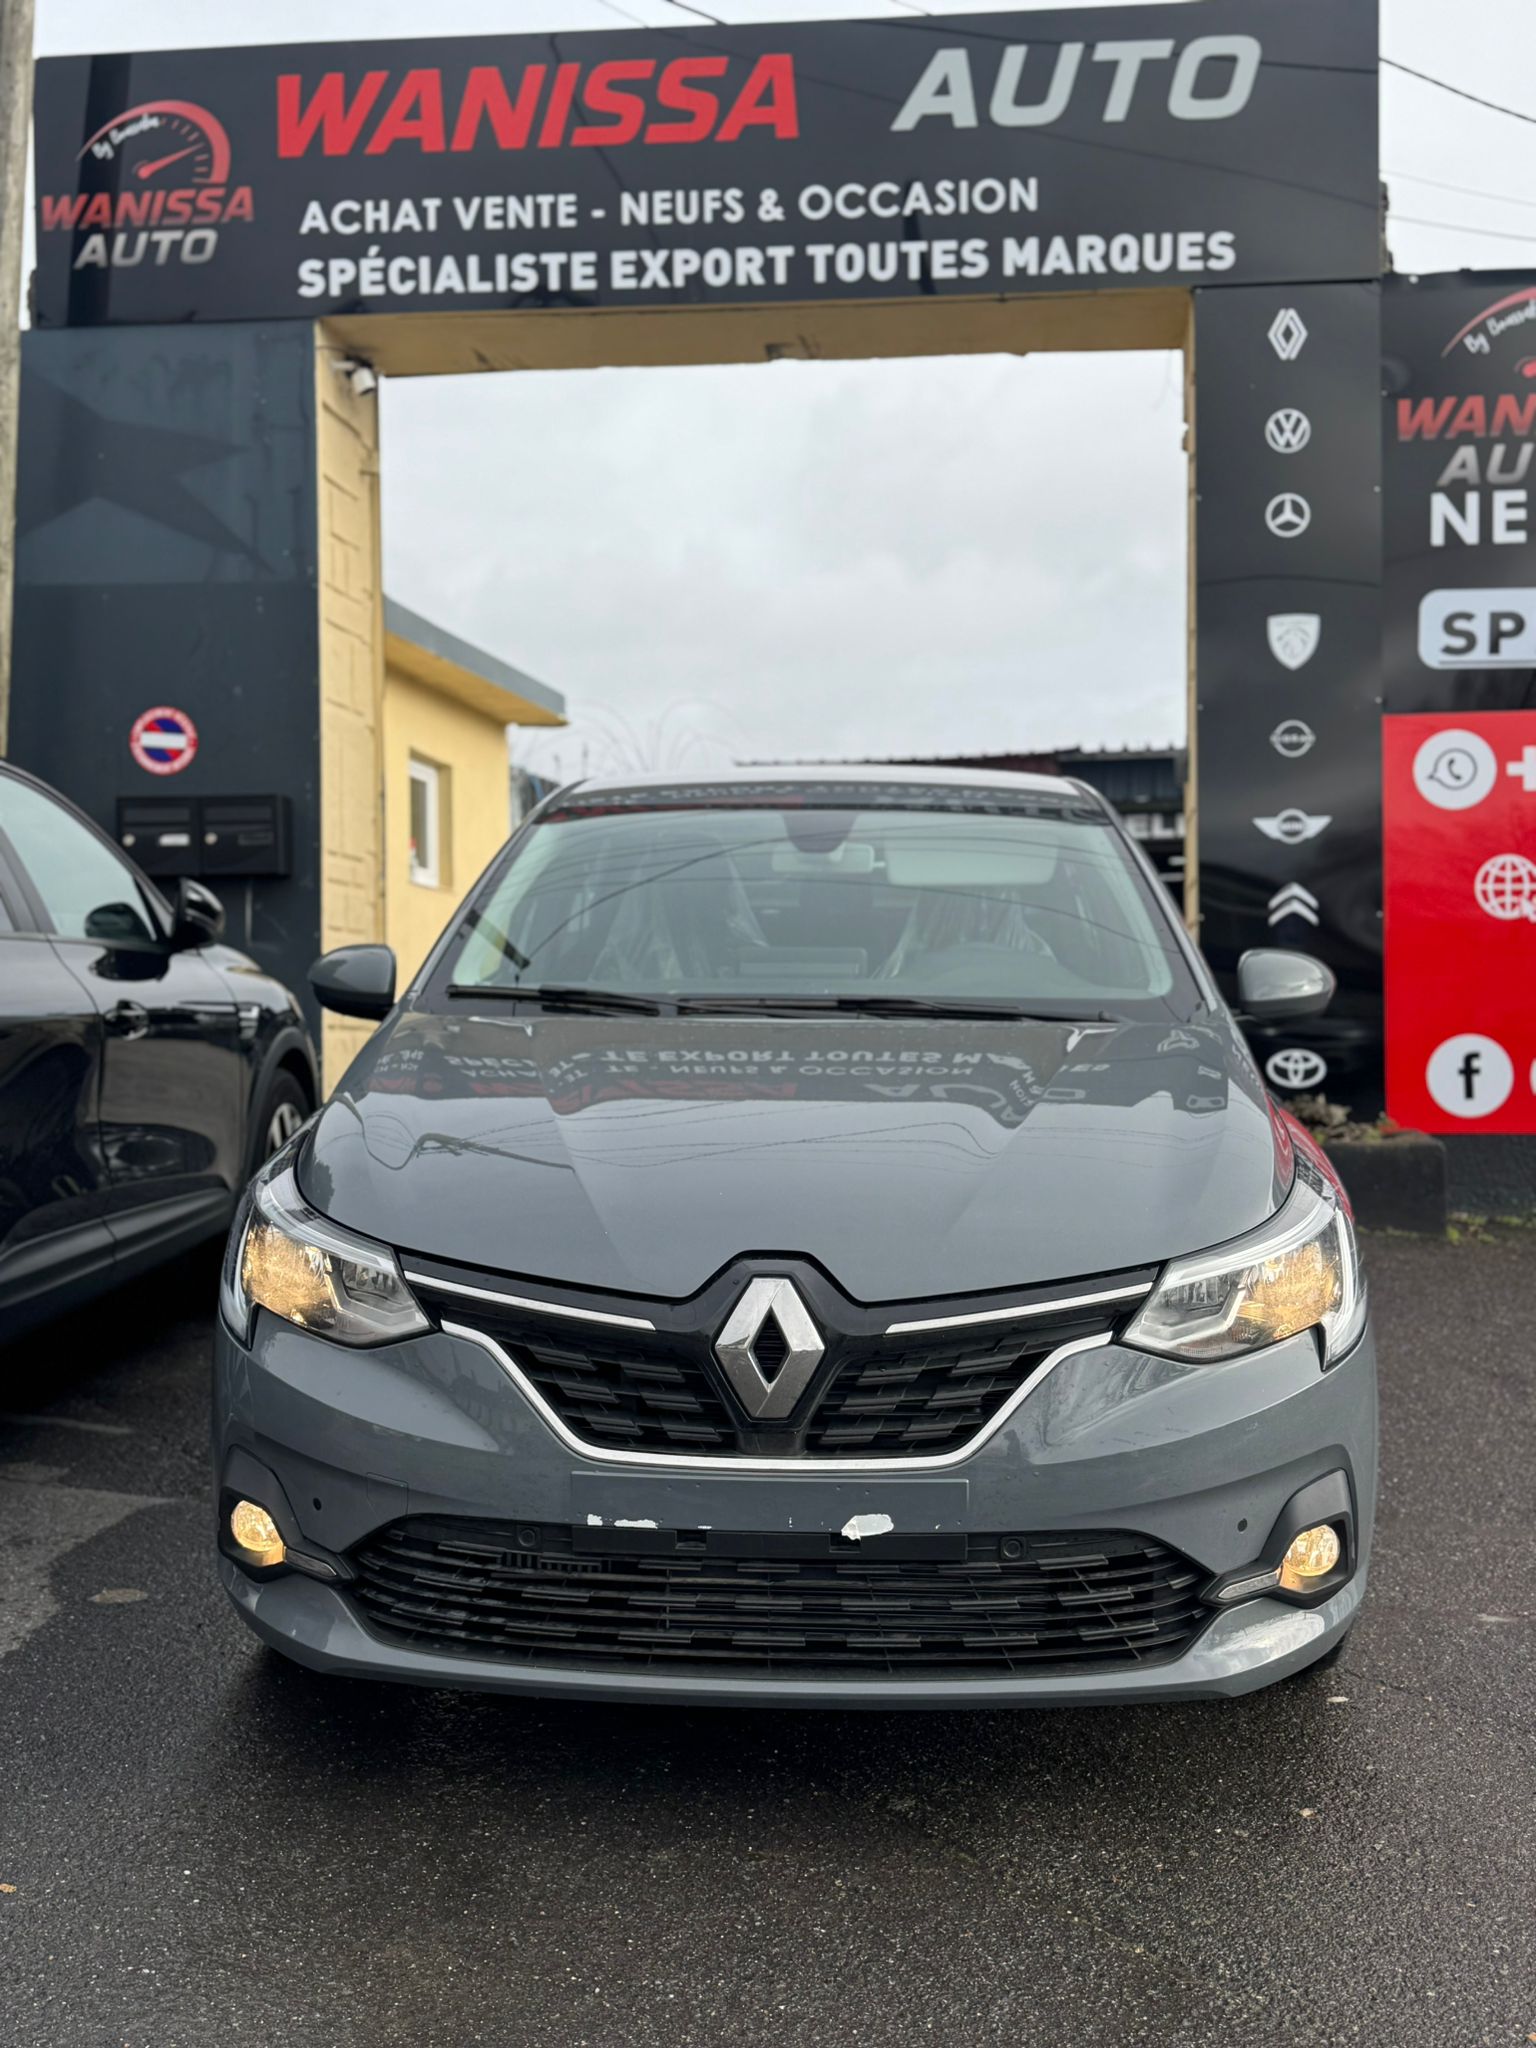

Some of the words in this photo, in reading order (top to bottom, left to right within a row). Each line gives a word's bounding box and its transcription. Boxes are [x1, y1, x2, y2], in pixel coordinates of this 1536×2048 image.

[276, 53, 799, 159] WANISSA
[890, 33, 1263, 133] AUTO
[41, 186, 254, 231] WANISSA
[299, 197, 443, 236] ACHAT
[451, 193, 578, 231] VENTE
[619, 187, 746, 226] NEUFS
[756, 188, 786, 222] &
[798, 177, 1039, 221] OCCASION
[75, 228, 218, 269] AUTO
[297, 245, 598, 298] SPÉCIALISTE
[609, 245, 796, 291] EXPORT
[805, 238, 990, 285] TOUTES
[1002, 230, 1237, 278] MARQUES
[1397, 392, 1536, 441] WAN
[1437, 441, 1536, 487] AU
[1430, 488, 1529, 547] NE
[1440, 611, 1536, 656] SP
